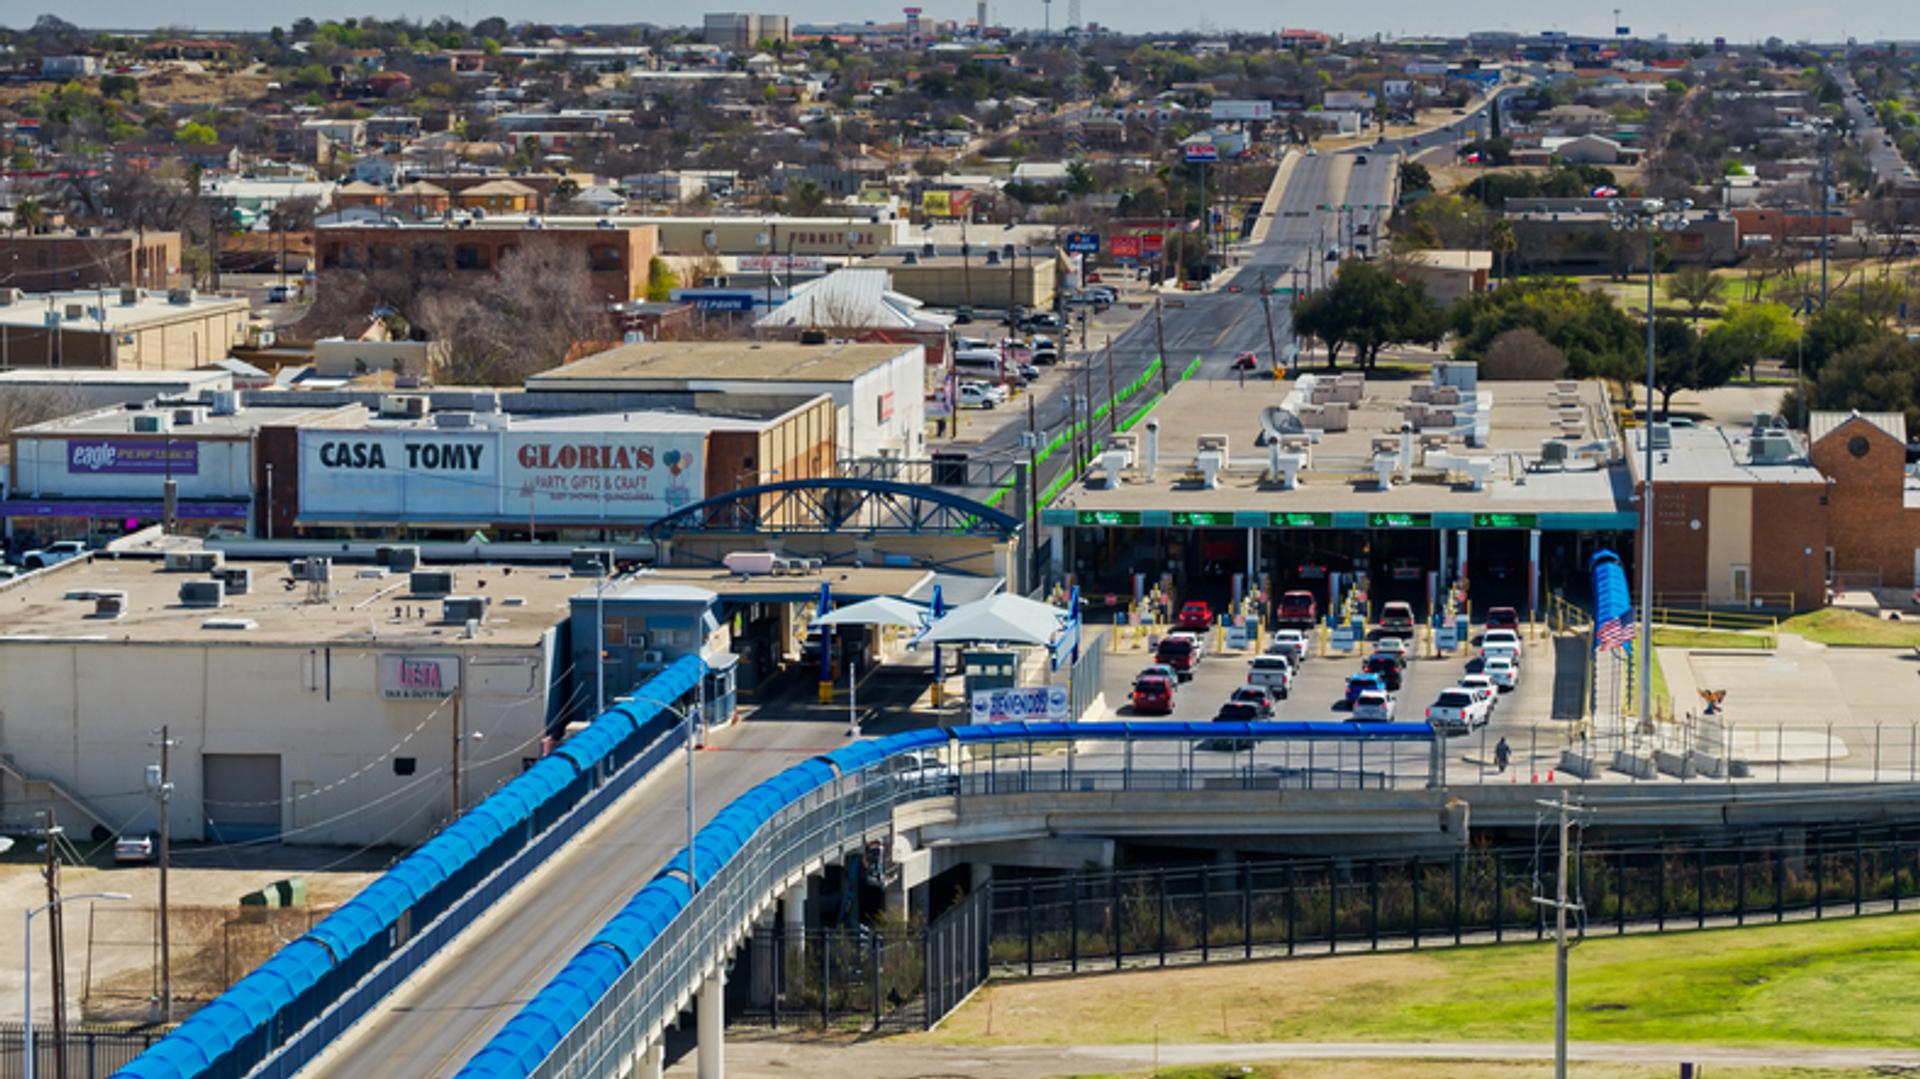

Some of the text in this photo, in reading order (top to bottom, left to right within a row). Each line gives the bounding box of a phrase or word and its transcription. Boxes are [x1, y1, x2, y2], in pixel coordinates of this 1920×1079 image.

[788, 232, 875, 245] FURNITRE
[73, 442, 116, 470] eagle
[319, 441, 484, 470] CASA TOMY
[517, 444, 655, 471] GLORIA'S
[571, 475, 600, 490] GIFTS
[614, 475, 648, 490] CRAFT
